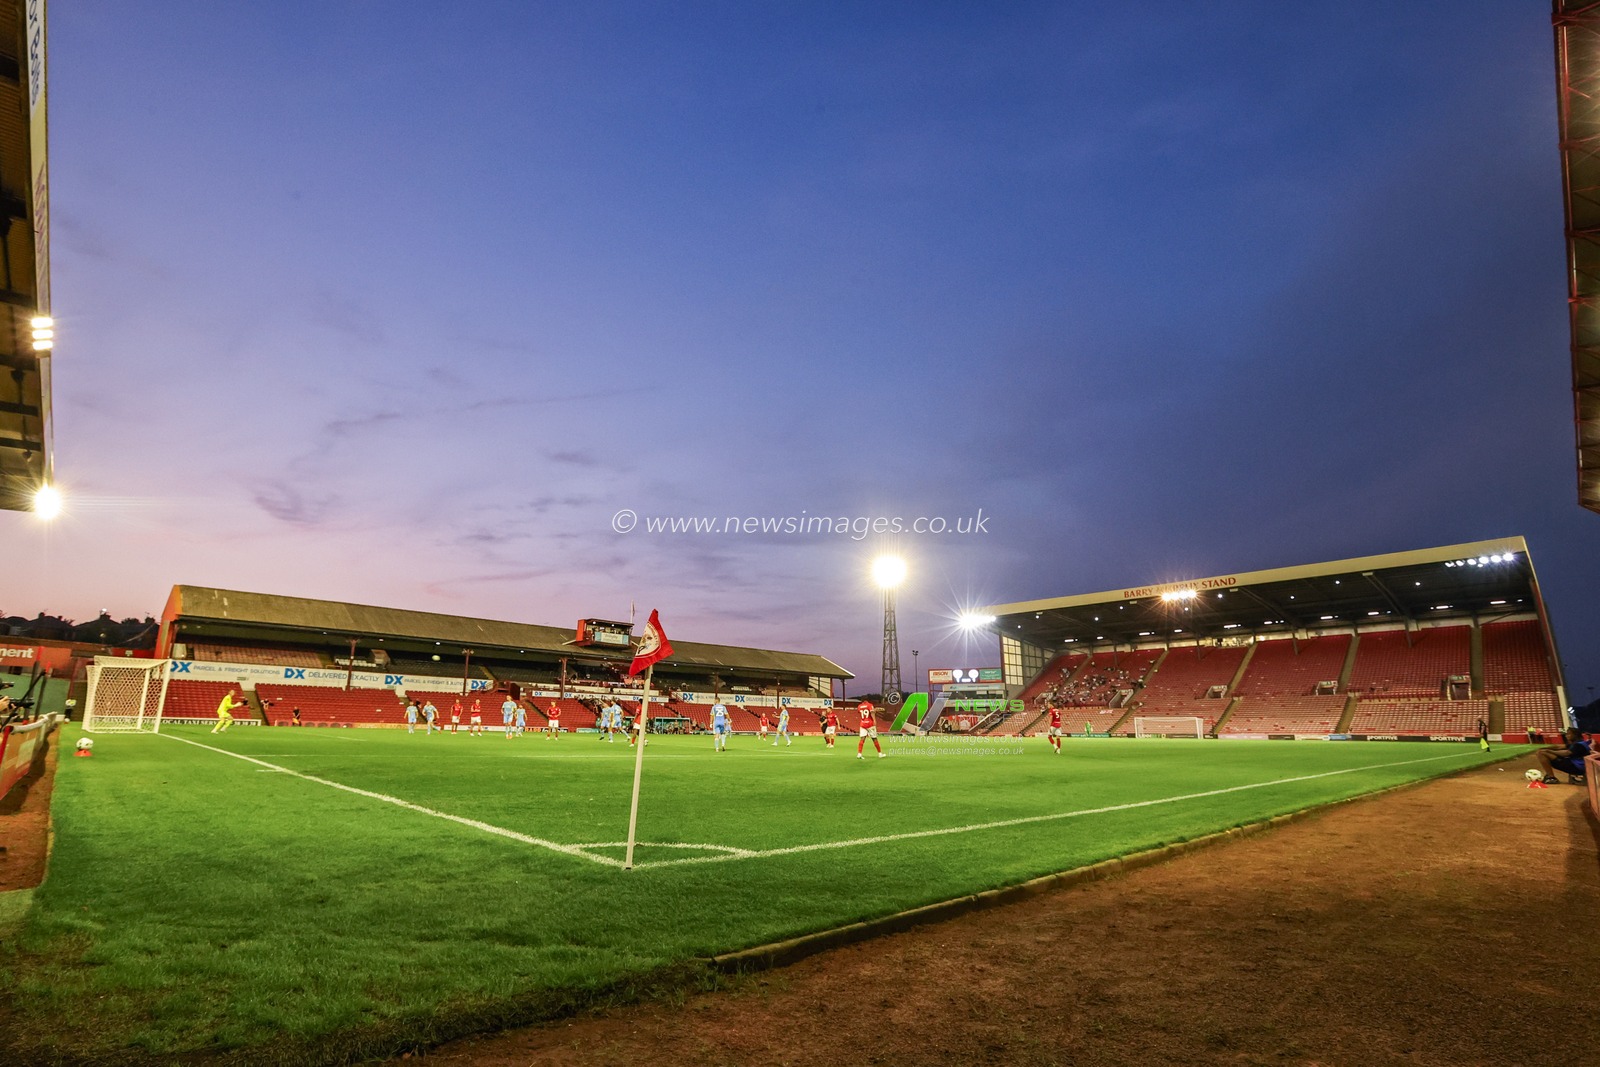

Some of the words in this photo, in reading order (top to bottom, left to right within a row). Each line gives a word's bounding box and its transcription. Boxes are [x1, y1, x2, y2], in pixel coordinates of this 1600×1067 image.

[1123, 587, 1154, 598] BARRY
[1201, 577, 1237, 588] STAND
[284, 667, 306, 679] DX
[308, 671, 348, 680] DELIVERED
[350, 673, 380, 682] EXACTLY
[384, 674, 404, 685] DX
[470, 679, 487, 690] DX
[682, 692, 694, 701] DX
[734, 694, 745, 703] DX
[781, 697, 791, 705] DX
[859, 709, 870, 719] 19
[1055, 711, 1060, 719] 5
